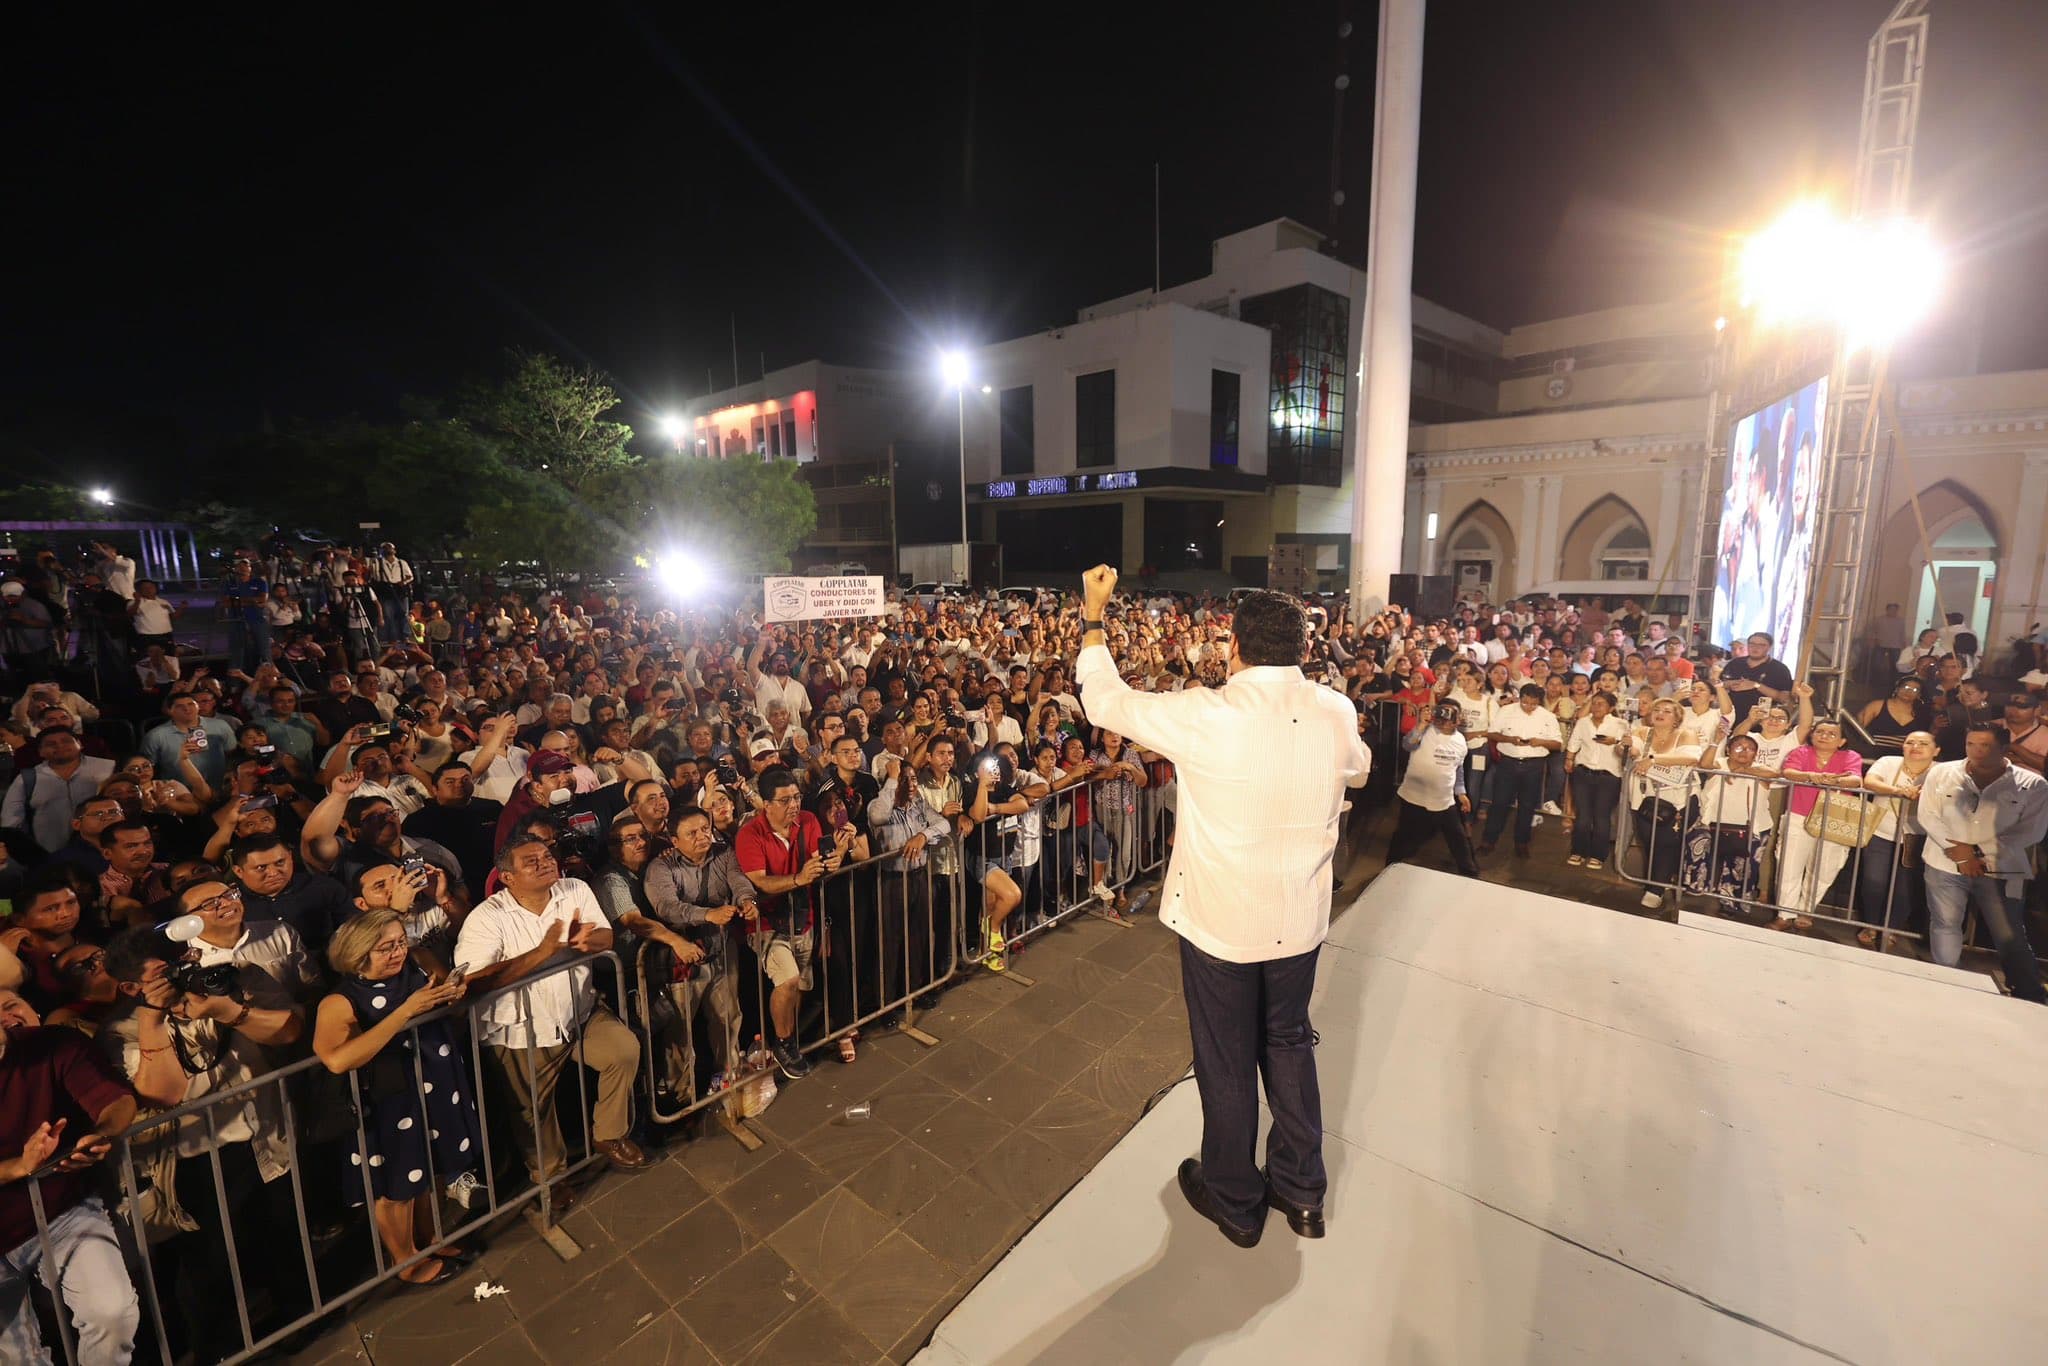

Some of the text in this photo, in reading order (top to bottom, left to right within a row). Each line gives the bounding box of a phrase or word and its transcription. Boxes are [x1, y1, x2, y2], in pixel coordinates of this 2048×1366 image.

[810, 589, 866, 597] CONDUCTORES
[836, 599, 842, 607] Y
[860, 598, 875, 606] CON
[823, 608, 867, 617] JAVIER MAY
